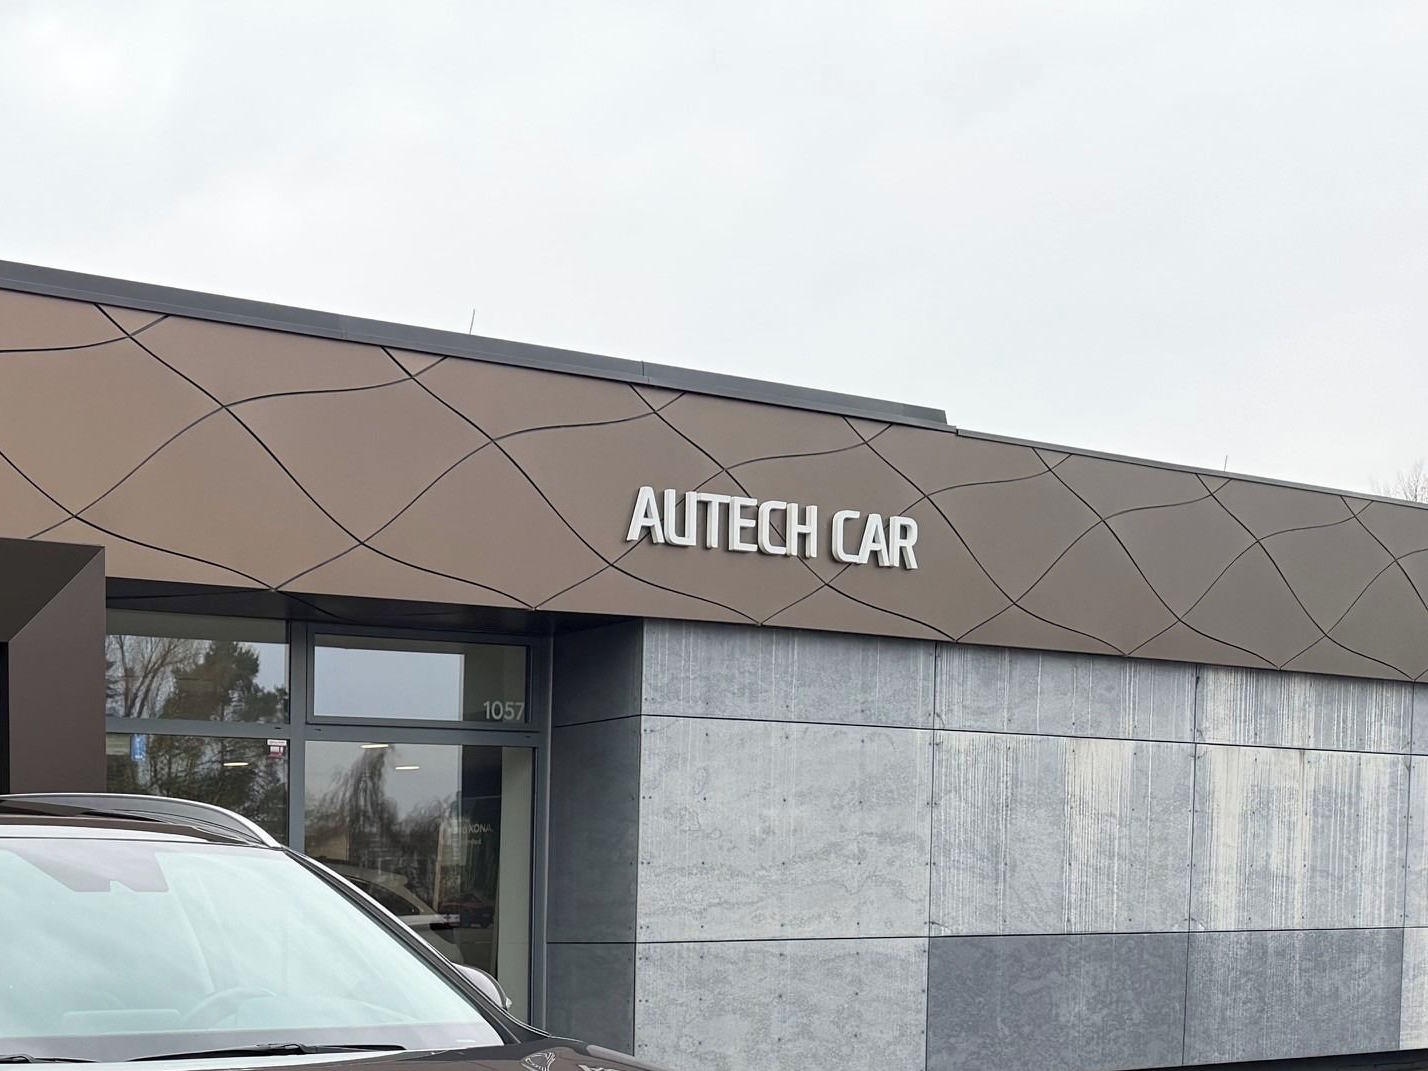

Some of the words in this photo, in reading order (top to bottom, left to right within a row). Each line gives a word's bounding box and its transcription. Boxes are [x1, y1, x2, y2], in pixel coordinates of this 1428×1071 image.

[626, 486, 818, 558] AUTECH
[831, 510, 919, 570] CAR
[483, 700, 525, 720] 1057
